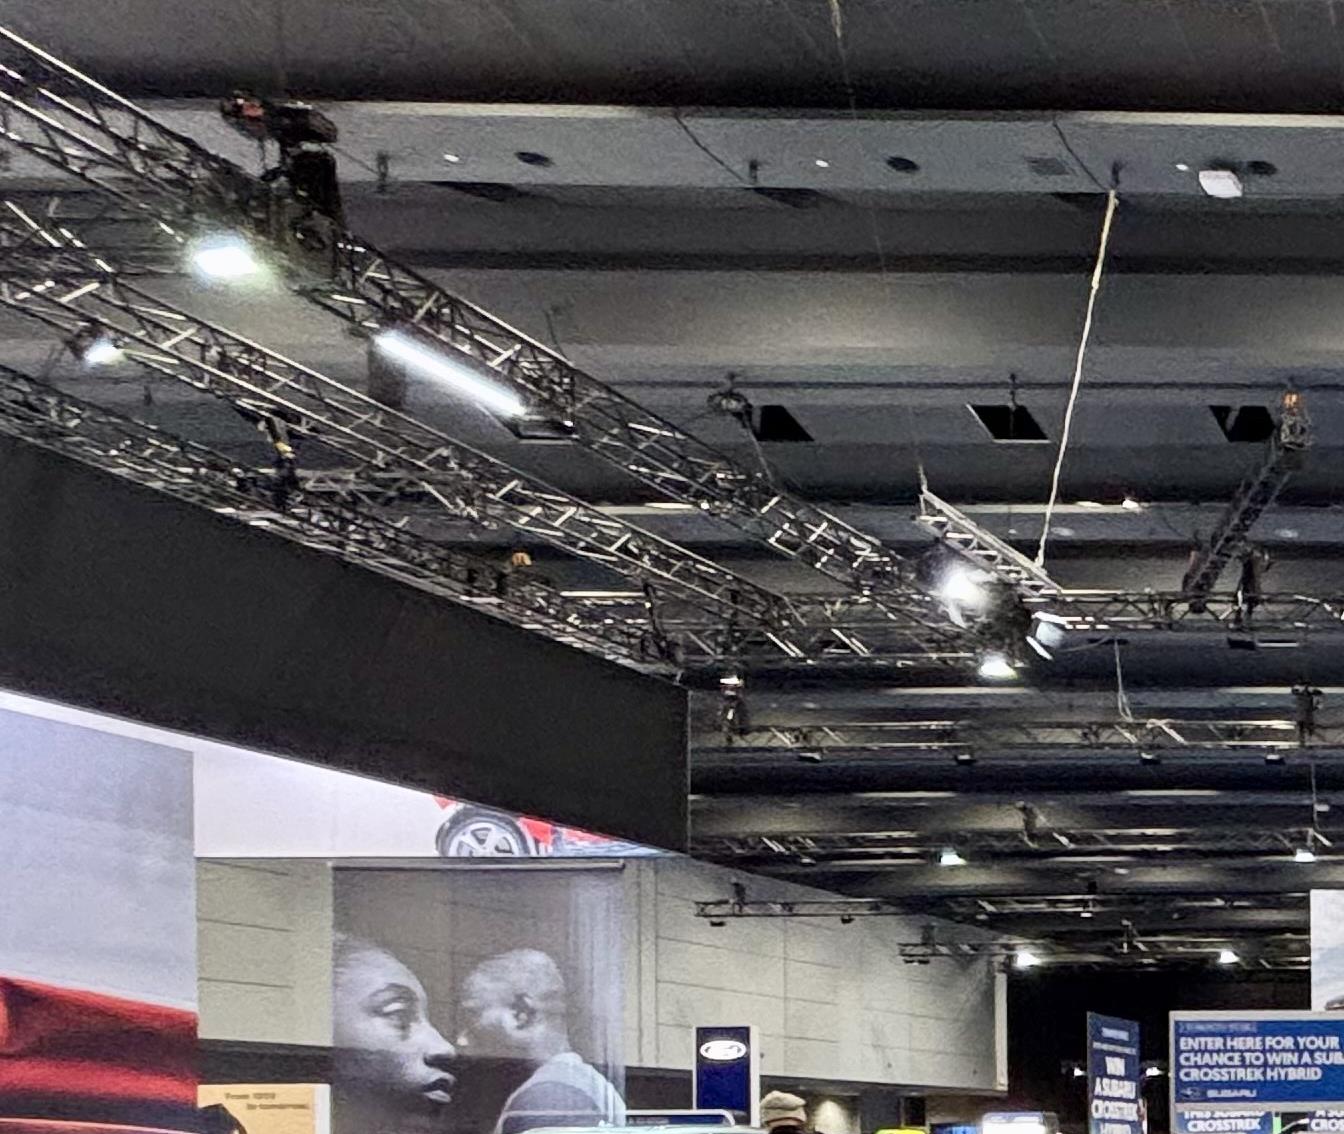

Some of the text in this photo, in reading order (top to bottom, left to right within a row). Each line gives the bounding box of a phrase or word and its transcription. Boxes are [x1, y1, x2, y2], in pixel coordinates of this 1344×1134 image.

[1180, 1035, 1340, 1051] ENTER HERE FOR YOUR
[1179, 1051, 1242, 1066] CHANCE
[1243, 1051, 1265, 1066] TO
[1266, 1051, 1299, 1066] WIN
[1300, 1051, 1312, 1065] A
[1179, 1066, 1323, 1081] CROSSTREK HYBRID
